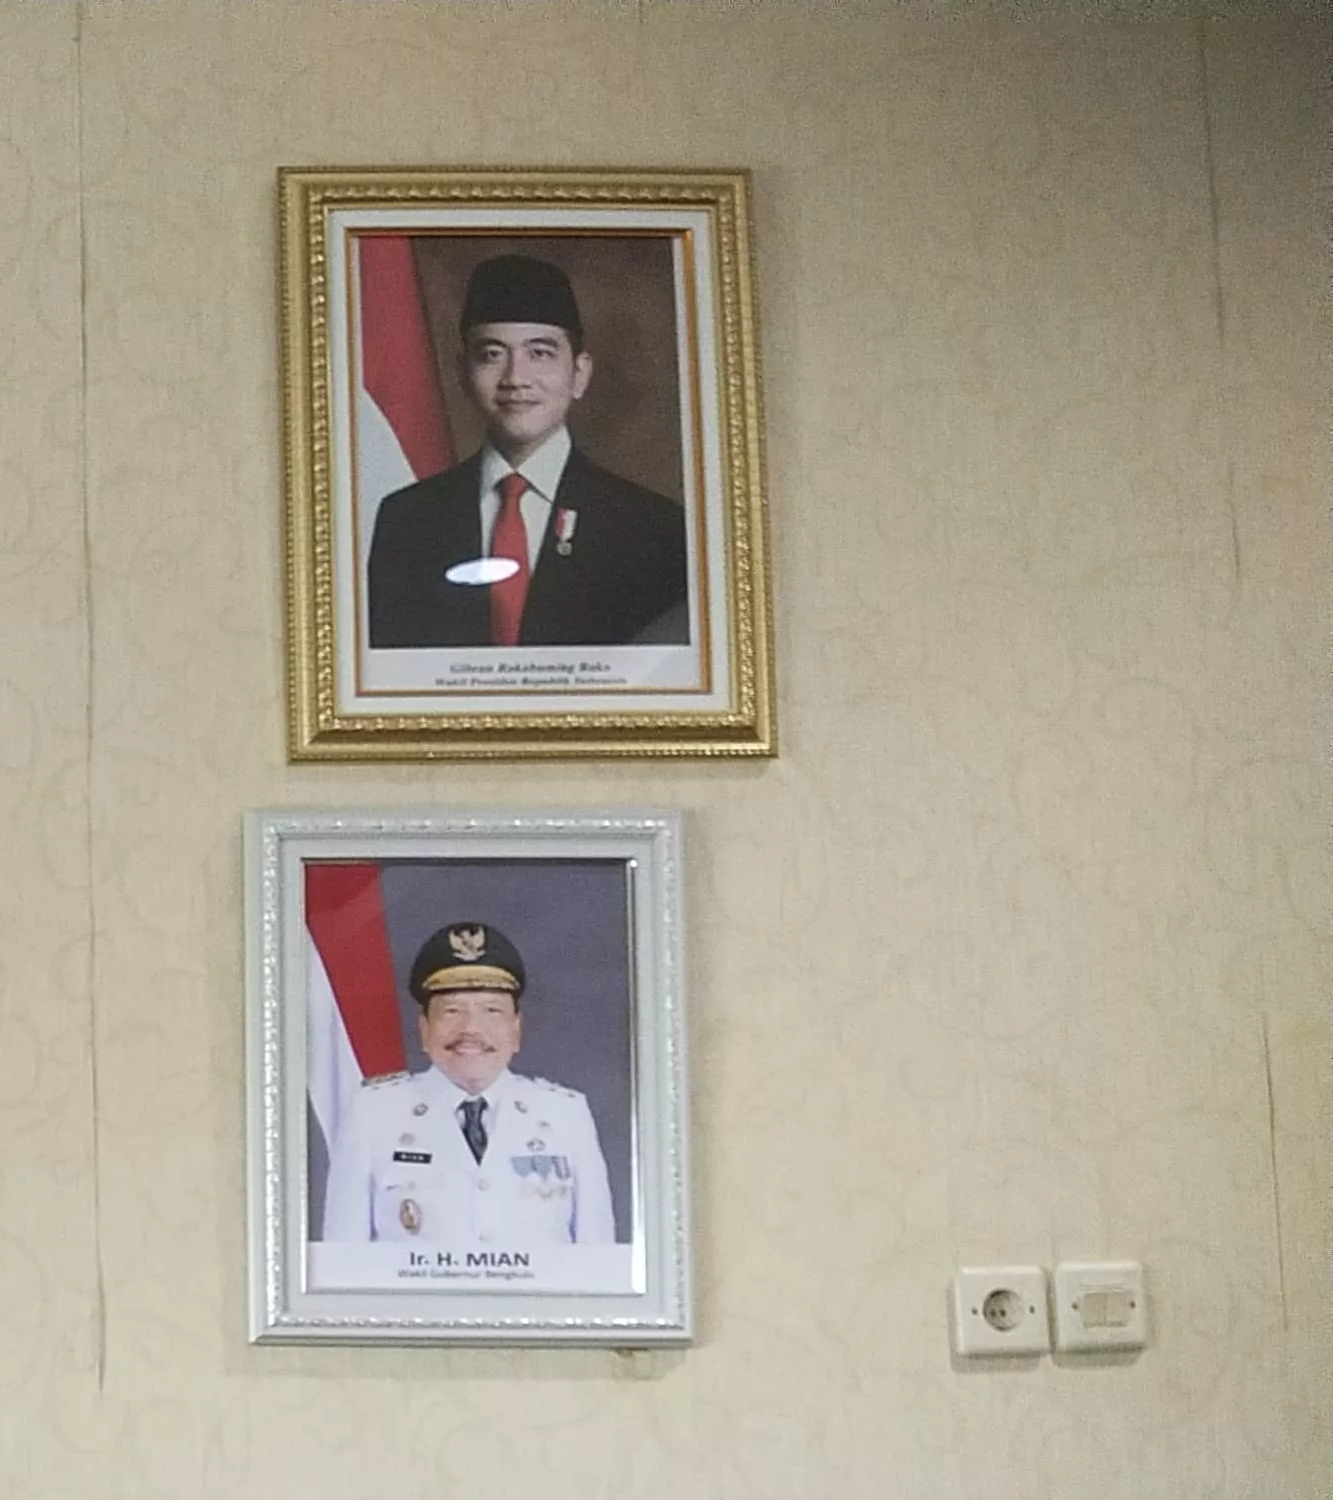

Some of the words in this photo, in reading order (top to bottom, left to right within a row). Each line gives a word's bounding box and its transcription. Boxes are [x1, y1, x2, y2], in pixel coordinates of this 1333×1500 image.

[409, 1251, 430, 1267] Ir.
[437, 1252, 460, 1267] H.
[466, 1252, 530, 1268] MIAN
